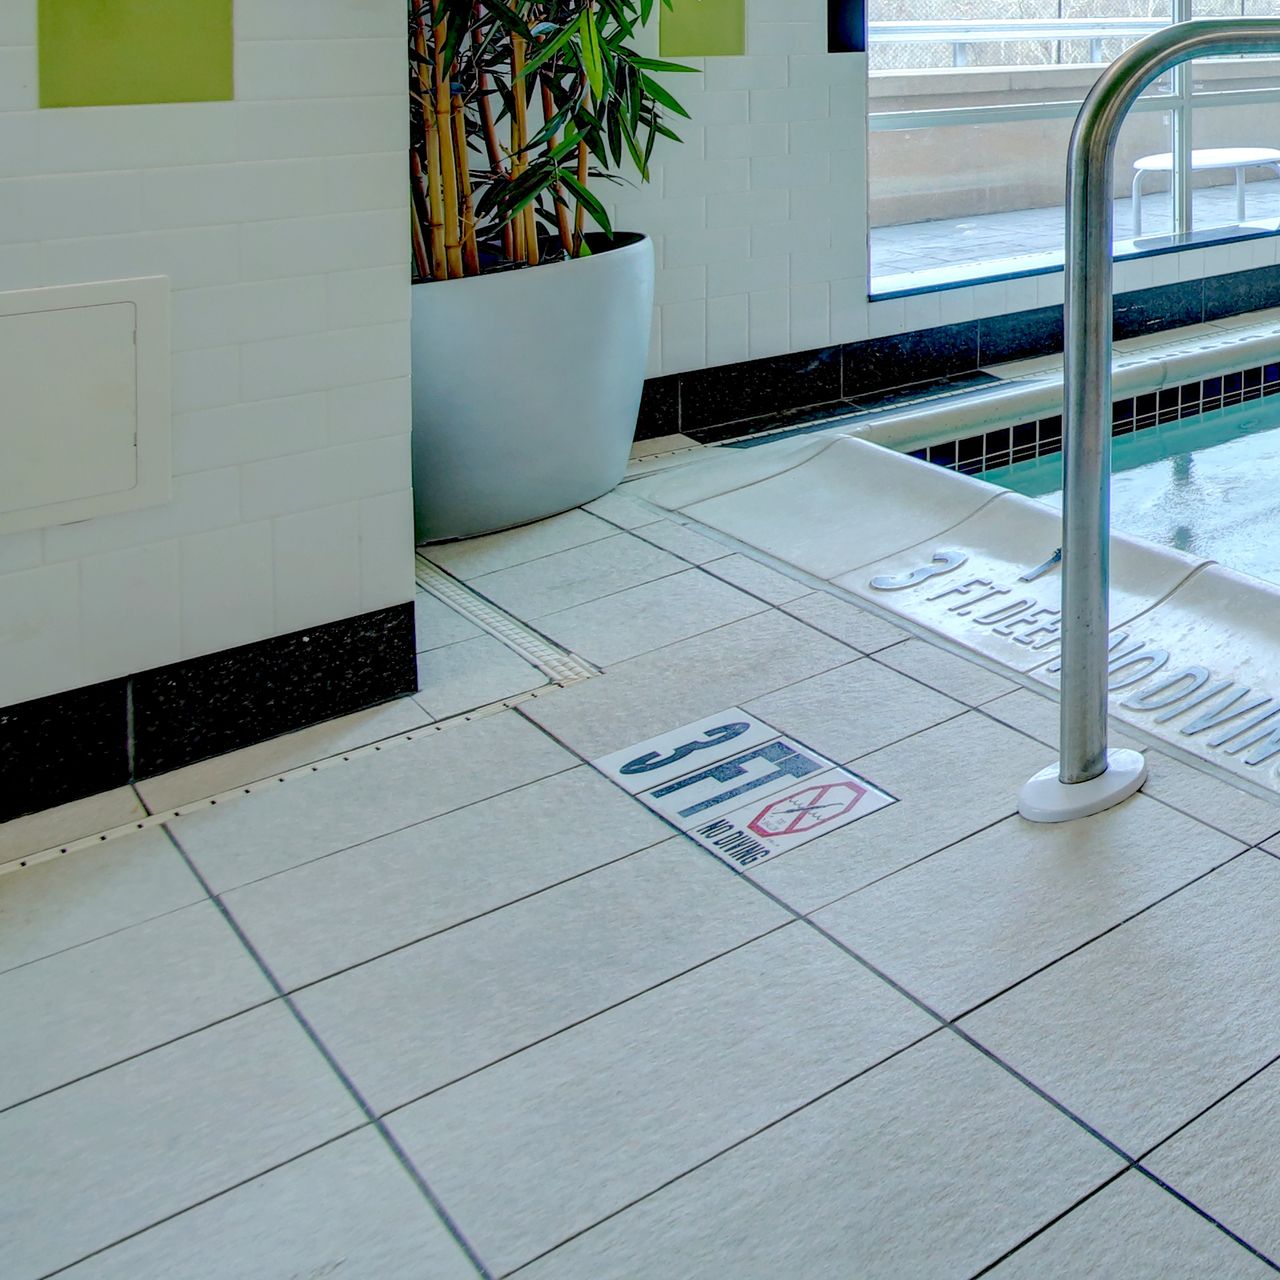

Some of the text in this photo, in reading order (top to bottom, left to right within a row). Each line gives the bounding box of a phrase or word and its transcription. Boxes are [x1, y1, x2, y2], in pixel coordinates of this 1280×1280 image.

[868, 550, 1062, 650] 3 FT. DEE
[619, 721, 824, 819] 3 FT
[696, 818, 771, 866] NO DIVING
